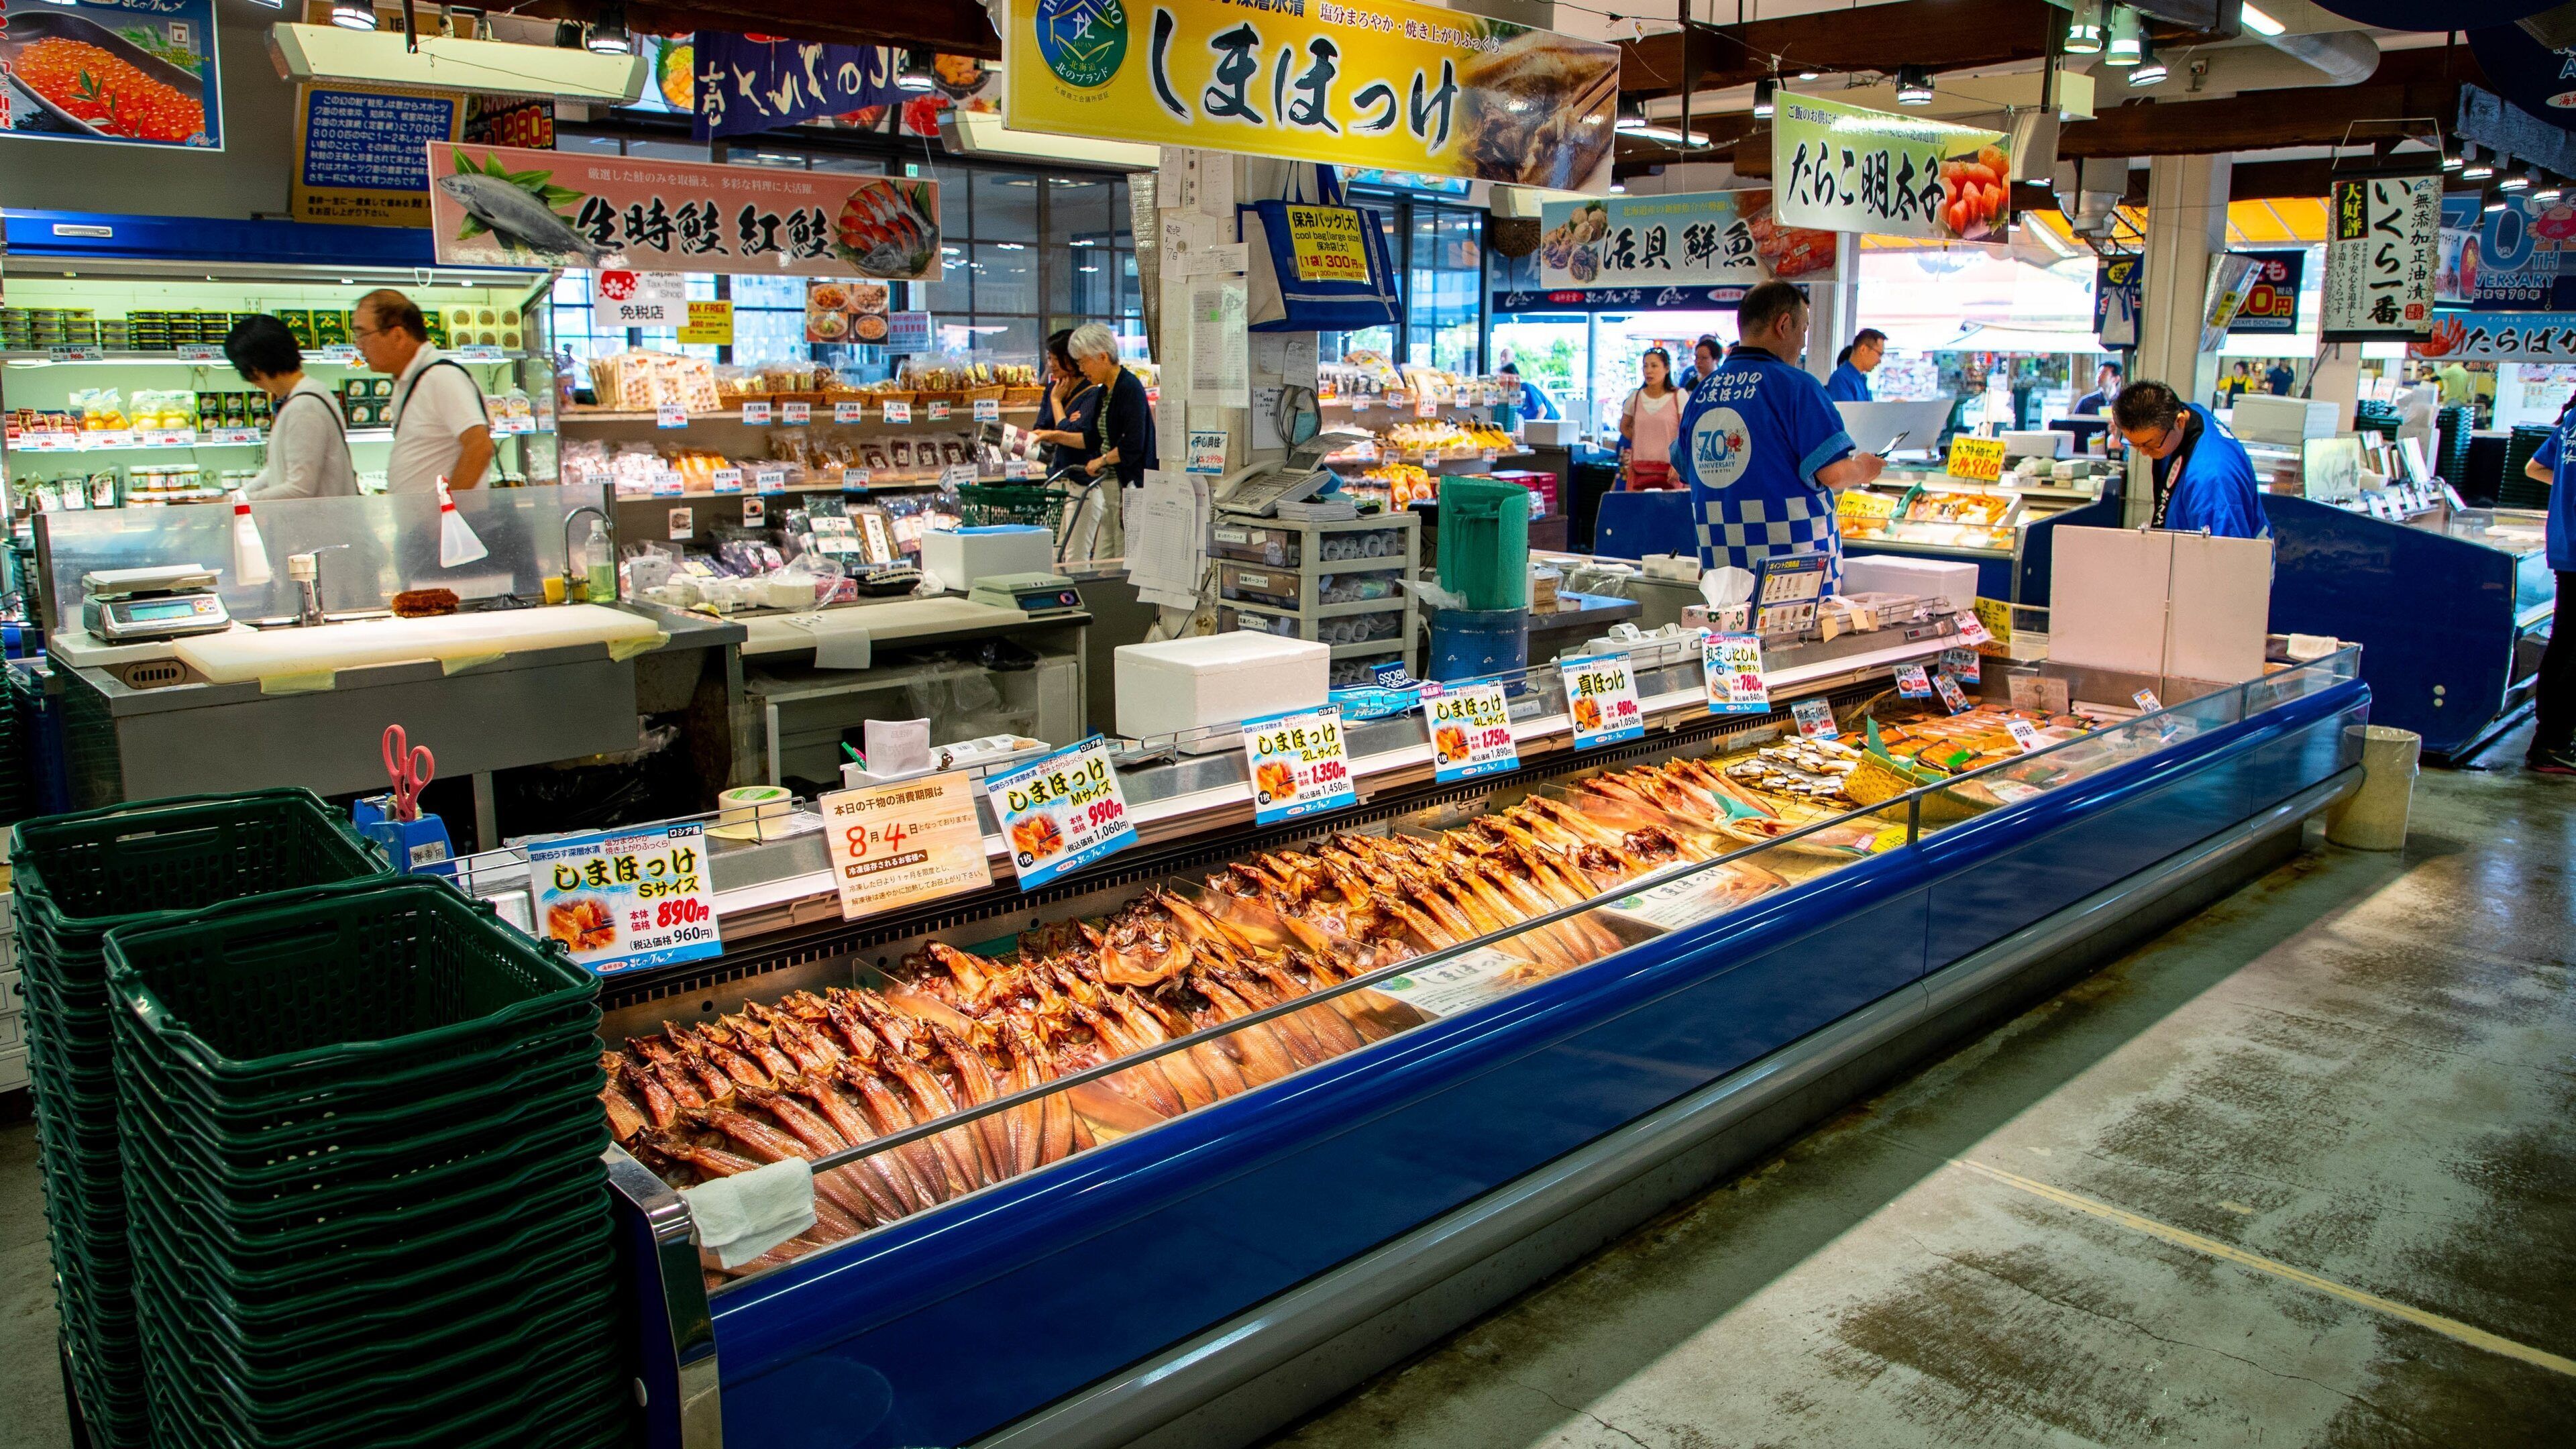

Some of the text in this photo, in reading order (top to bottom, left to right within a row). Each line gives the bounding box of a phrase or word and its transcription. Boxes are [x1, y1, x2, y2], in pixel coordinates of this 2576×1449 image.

[1320, 3, 1501, 54] 塩分まろやか・焼き上がりふっくら
[1054, 61, 1108, 85] 北のブランド
[1069, 61, 1097, 72] 北海道
[1151, 7, 1459, 153] しまほっけ
[1786, 141, 1946, 224] たらこ明太子
[2343, 183, 2363, 238] 大好評
[576, 196, 837, 260] 生時鮭 紅鮭
[1295, 231, 1311, 239] cool
[1682, 221, 1757, 270] 鮮魚
[2366, 179, 2412, 325] いくら一番
[2407, 193, 2432, 301] 無添加正油漬
[647, 280, 682, 288] Tax-free
[659, 290, 683, 300] Shop
[620, 305, 664, 320] 免税店
[704, 303, 727, 314] FREE
[1698, 429, 1728, 462] 70
[1578, 669, 1625, 697] 真ほっけ
[1740, 674, 1763, 692] 780円
[1436, 693, 1501, 720] しまほっけ
[1617, 700, 1638, 717] 980円
[1473, 712, 1507, 727] 4Lサイズ
[1258, 722, 1336, 755] しまほっけ
[1482, 728, 1510, 749] 1,750円
[1301, 743, 1342, 762] 2Lサイズ
[988, 769, 1038, 793] 知床らうす深層水漬
[1311, 761, 1347, 784] 1,350円
[1008, 757, 1105, 812] しまほっけ
[1070, 779, 1113, 807] Mサイズ
[833, 786, 945, 817] 本日の干物の消費期限は
[1088, 798, 1124, 828] 990円
[669, 826, 702, 837] ロシア産
[1069, 814, 1083, 826] 本体
[1072, 823, 1087, 835] 価格
[530, 845, 601, 863] 知床らうす深層水漬
[848, 852, 926, 875] 冷凍保存されるお客様へ
[1018, 853, 1034, 866] 1枚
[555, 847, 696, 891] しまほっけ
[639, 875, 699, 898] Sサイズ
[629, 909, 649, 920] 本体
[656, 898, 710, 928] 890円
[631, 920, 651, 932] 価格
[629, 949, 676, 967] 北のグルメ
